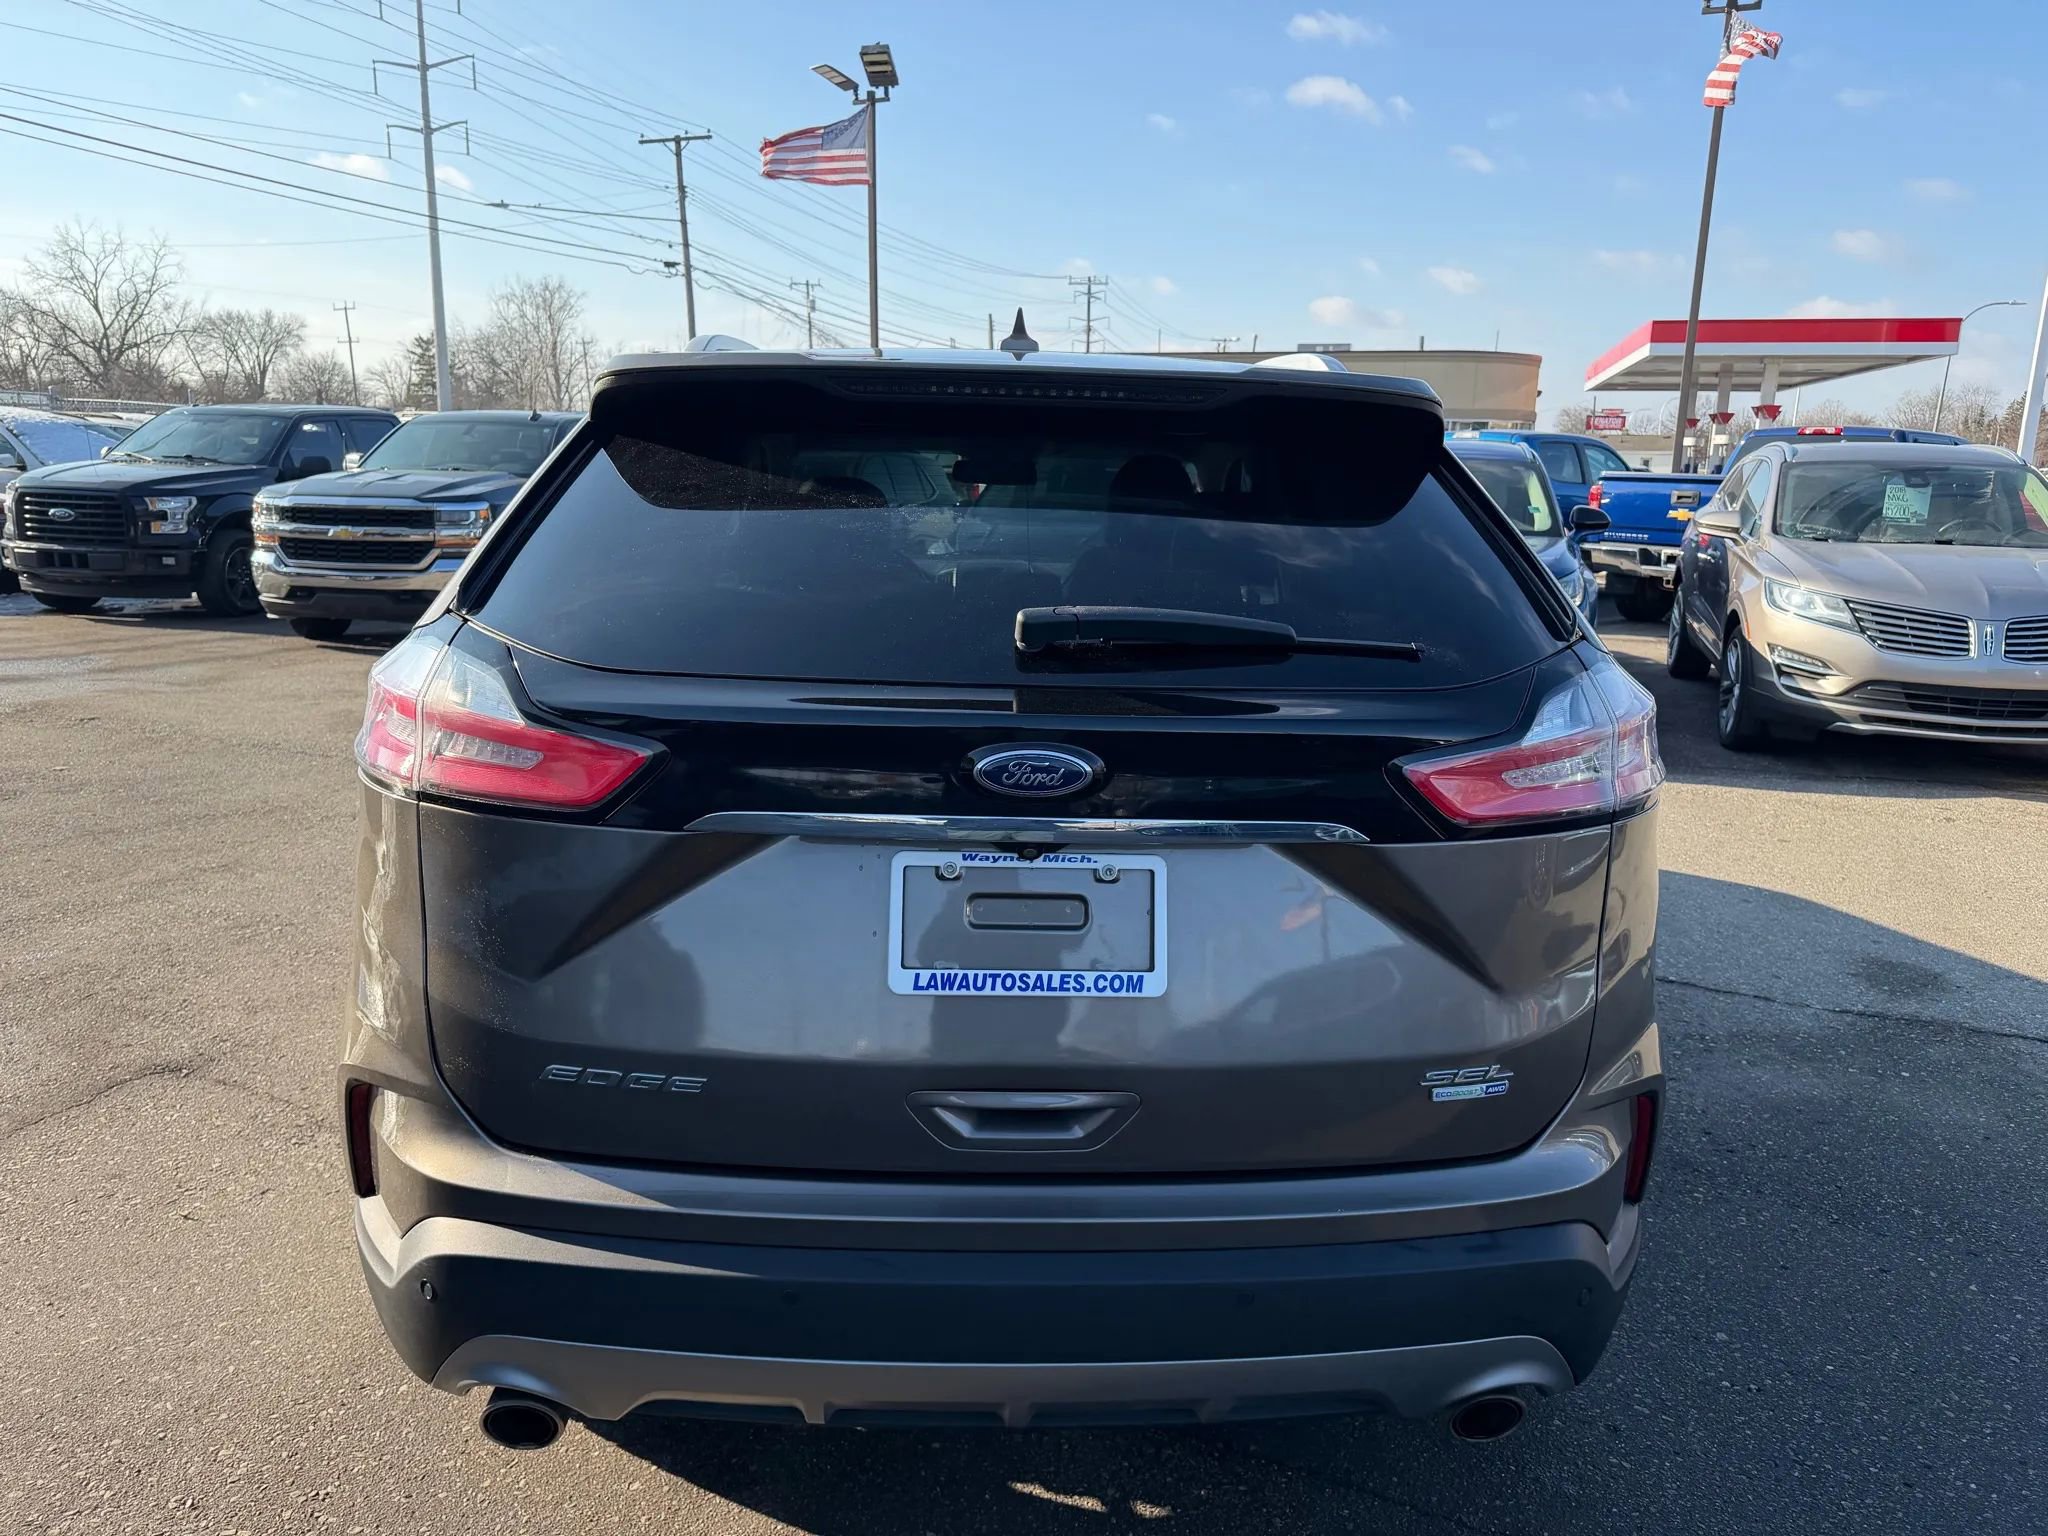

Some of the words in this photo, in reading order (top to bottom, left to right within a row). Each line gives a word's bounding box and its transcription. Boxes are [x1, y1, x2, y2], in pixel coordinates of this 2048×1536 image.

[1002, 760, 1065, 786] Ford
[1042, 854, 1098, 864] Mich.
[912, 972, 1145, 993] LAWAUTOSALES.COM
[539, 1064, 708, 1093] EDGE
[1420, 1064, 1514, 1086] SEL
[1486, 1085, 1506, 1094] AWD
